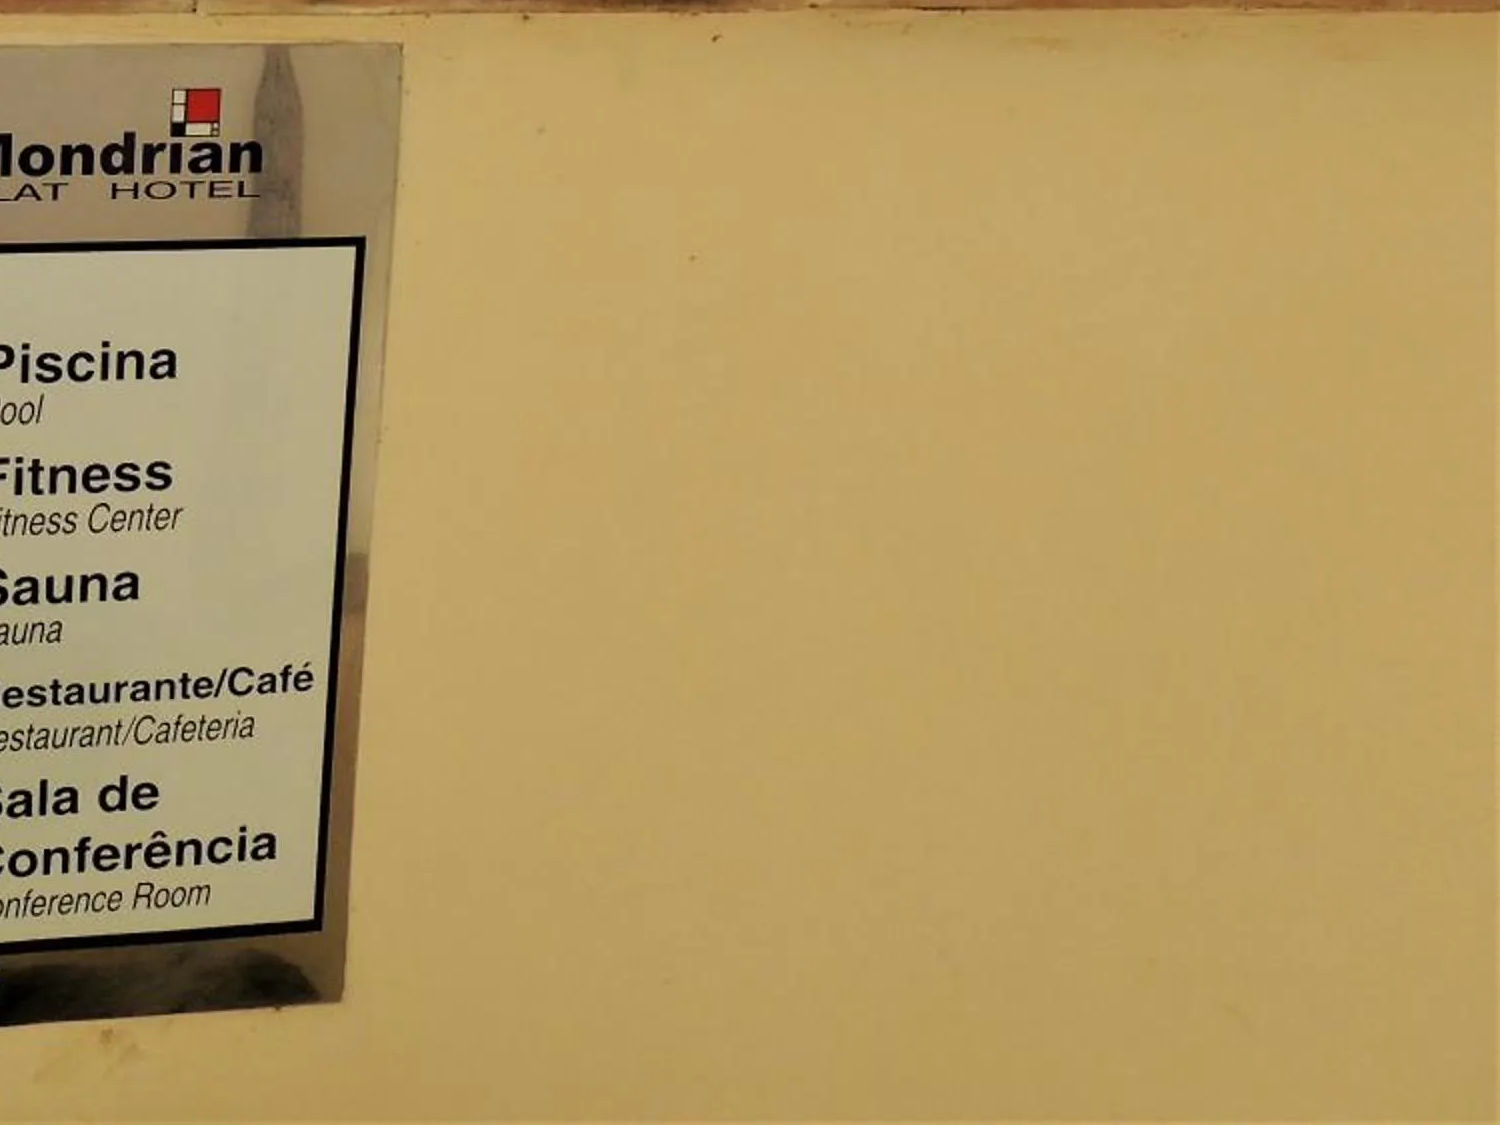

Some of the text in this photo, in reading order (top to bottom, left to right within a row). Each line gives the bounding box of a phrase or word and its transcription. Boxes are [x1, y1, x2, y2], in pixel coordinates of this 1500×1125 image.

[109, 180, 261, 199] HOTEL
[88, 503, 183, 533] Center
[98, 775, 159, 812] de
[132, 882, 210, 909] Room
